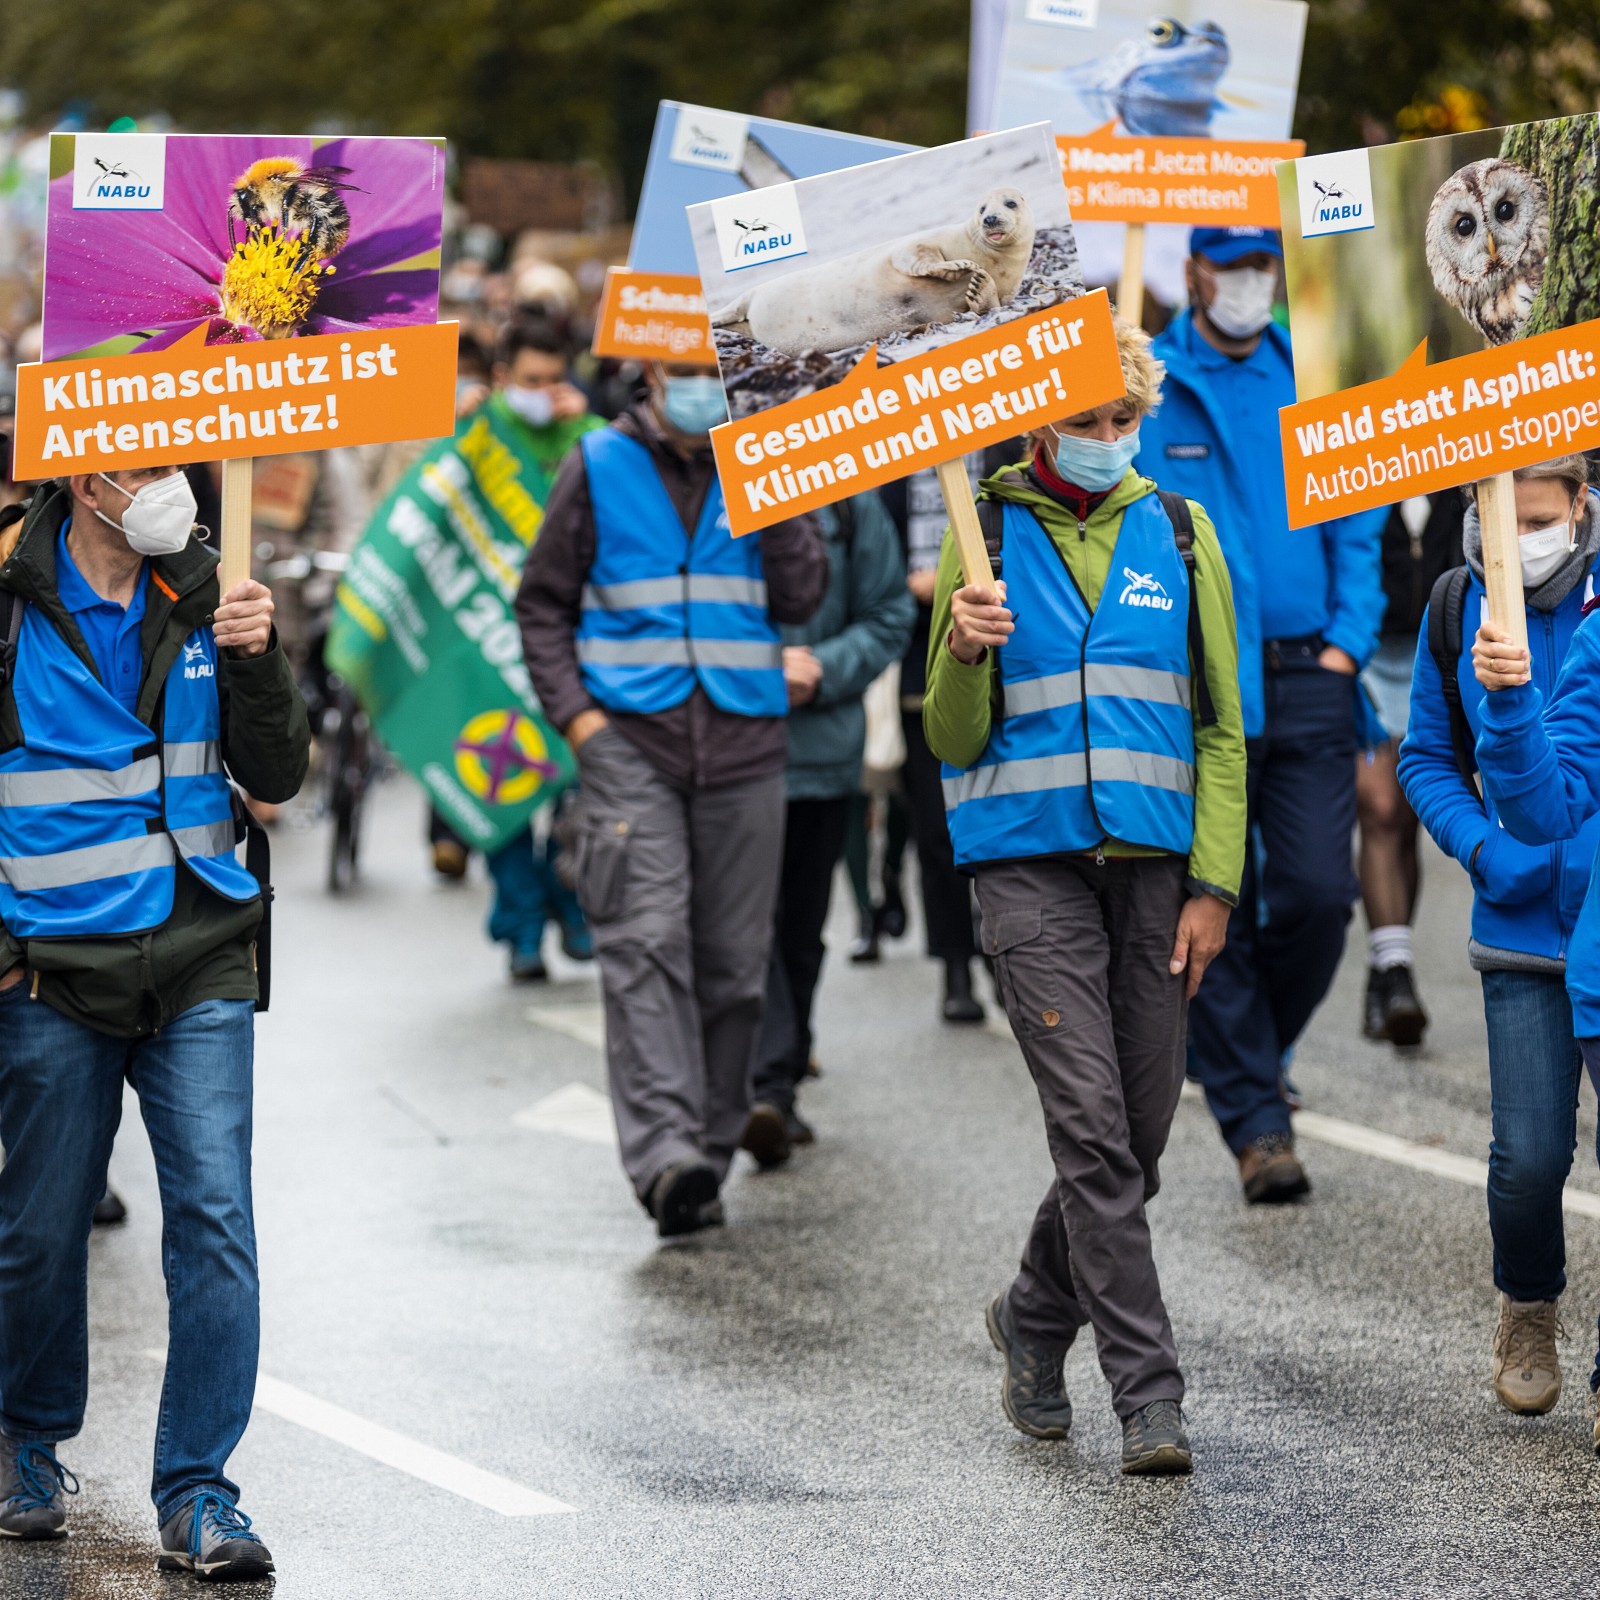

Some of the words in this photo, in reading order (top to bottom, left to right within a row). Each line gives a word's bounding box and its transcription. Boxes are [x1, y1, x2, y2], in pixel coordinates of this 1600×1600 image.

[1069, 147, 1145, 173] Moor!
[1150, 150, 1208, 176] Jetzt
[97, 185, 151, 198] NABU
[1087, 181, 1160, 208] Klima
[1164, 185, 1249, 211] retten!
[1319, 203, 1363, 221] NABU
[743, 233, 793, 255] NABU
[619, 285, 707, 314] Schna
[613, 316, 703, 355] haltige
[42, 355, 330, 412] Klimaschutz
[339, 342, 398, 381] ist
[734, 386, 901, 466] Gesunde
[903, 343, 1024, 406] Meere
[1025, 317, 1084, 362] für
[1295, 405, 1375, 457] Wald
[1380, 385, 1457, 434] statt
[1462, 349, 1596, 412] Asphalt:
[41, 394, 339, 460] Artenschutz!
[743, 452, 859, 513] Klima
[861, 413, 940, 469] und
[940, 367, 1067, 441] Natur!
[1304, 430, 1493, 505] Autobahnbau
[1499, 398, 1600, 451] stoppe
[1128, 593, 1173, 611] NABU
